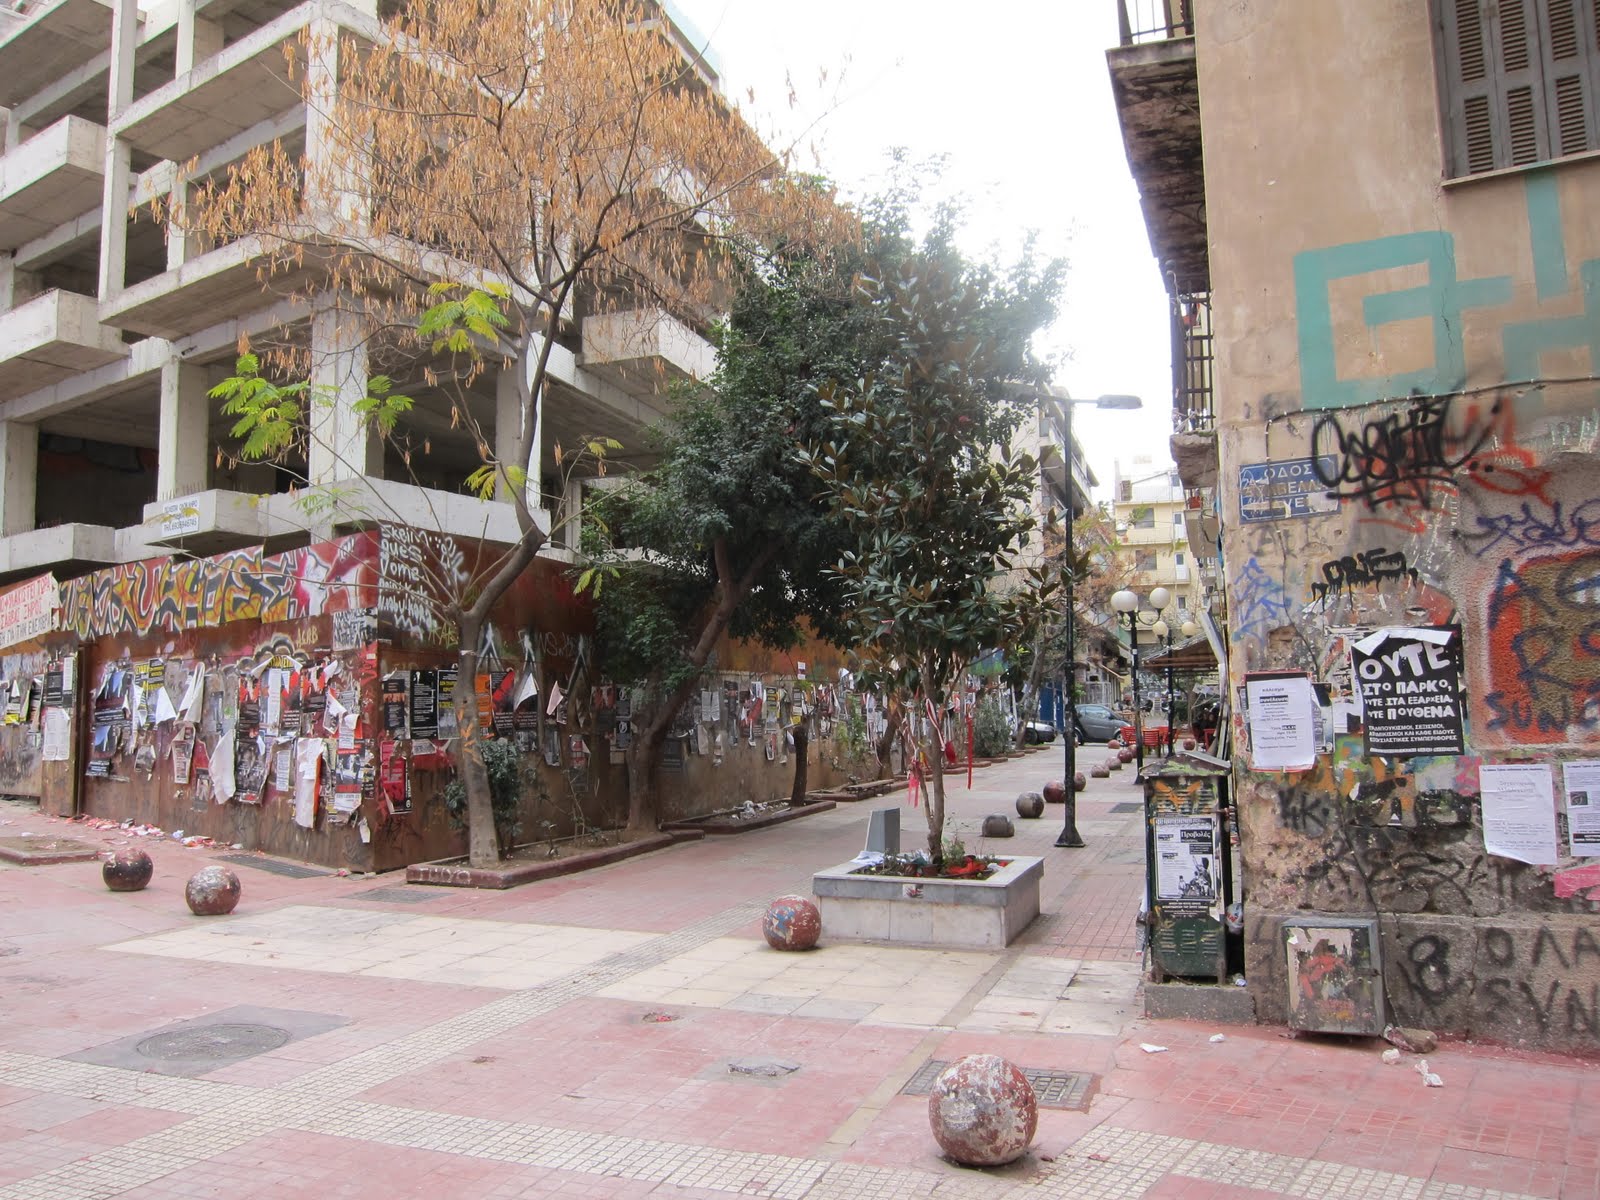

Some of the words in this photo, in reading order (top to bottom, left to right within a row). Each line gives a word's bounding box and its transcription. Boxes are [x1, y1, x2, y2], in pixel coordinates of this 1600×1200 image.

[1264, 463, 1312, 479] ΟΔΟΣ
[1359, 642, 1451, 680] ΟΥΤΕ
[1362, 682, 1391, 696] ΣΤΟ
[1395, 679, 1452, 695] ΠΑΡΚΟ,
[1364, 698, 1383, 707] ΥΤΕ
[1385, 696, 1406, 706] ΣΤΑ
[1407, 694, 1454, 705] ΕΞΑΡΧΕΙΑ,
[1367, 710, 1384, 719] ΥΤΕ
[1387, 705, 1456, 720] ΠΟΥΘΕΝΑ
